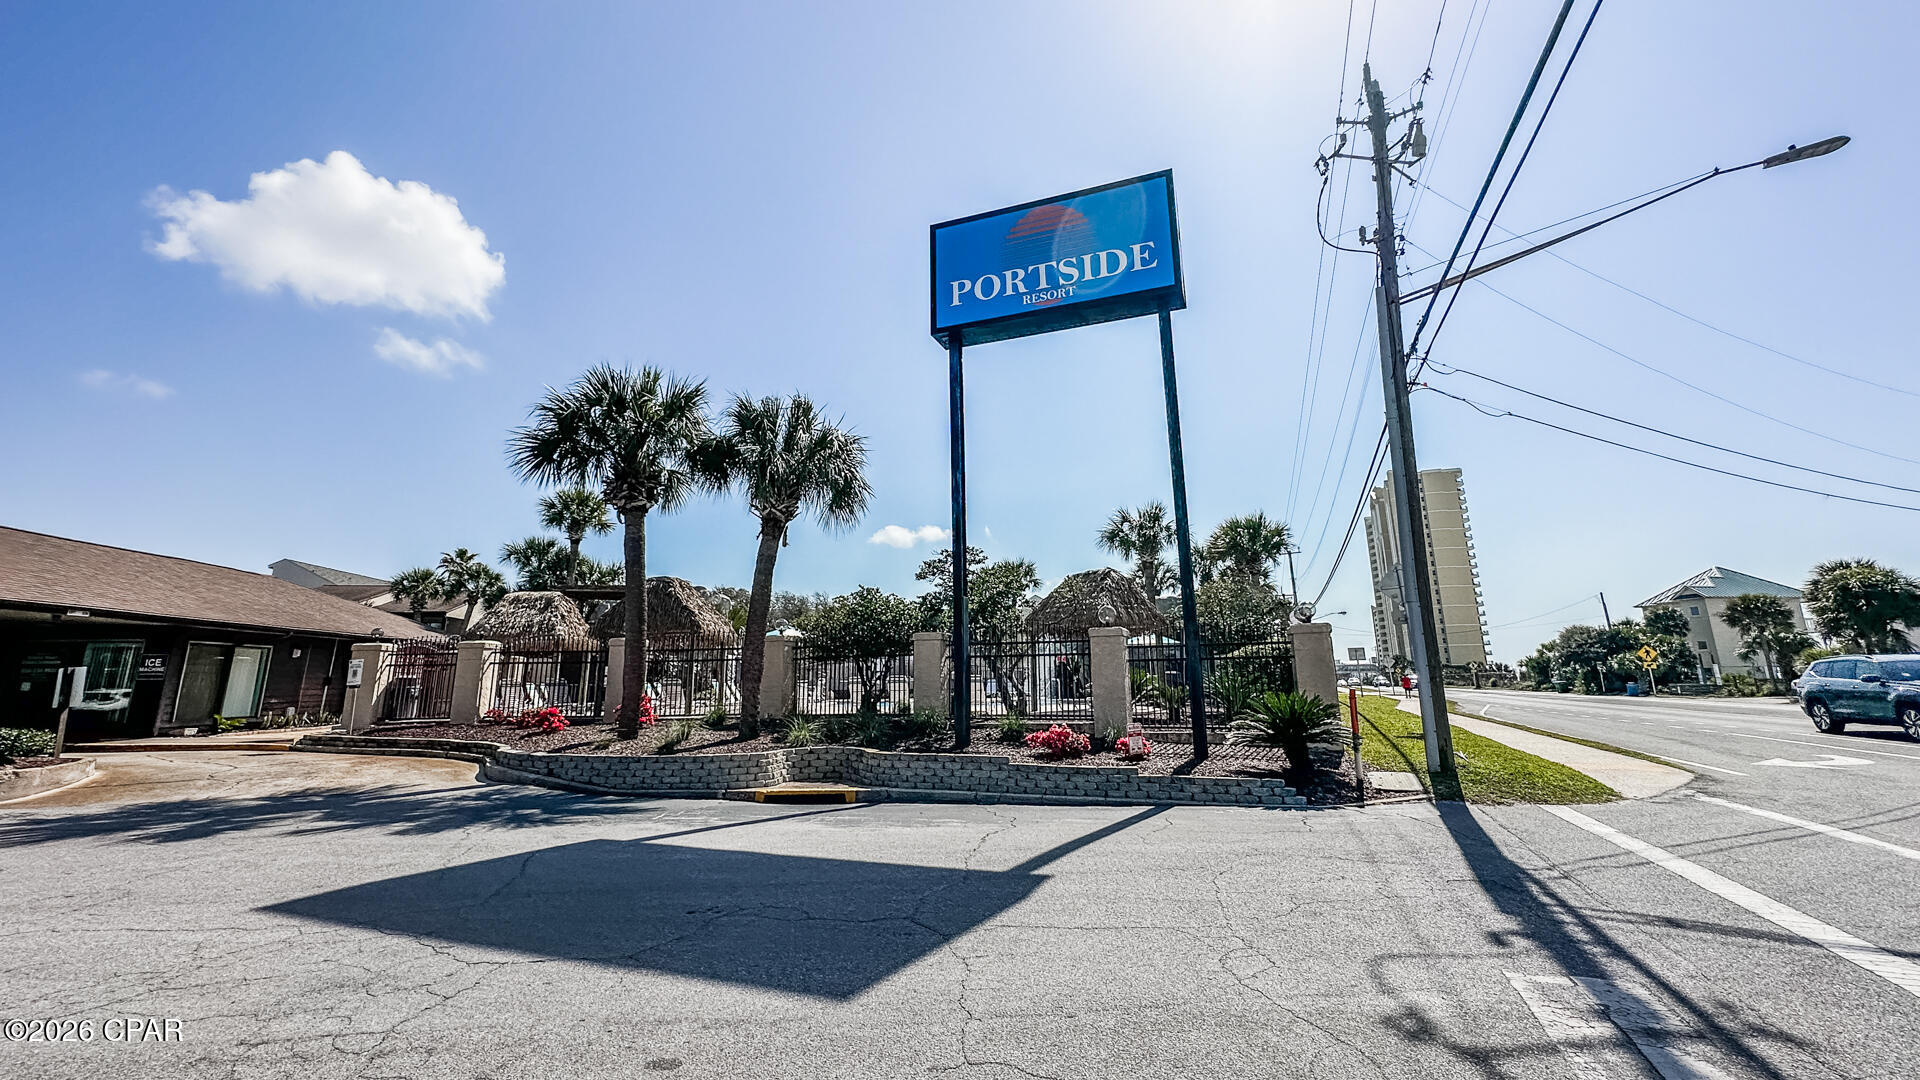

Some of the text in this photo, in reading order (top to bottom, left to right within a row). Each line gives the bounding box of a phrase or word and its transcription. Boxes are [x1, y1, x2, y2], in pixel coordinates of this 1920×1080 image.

[950, 241, 1158, 306] PORTSIDE
[1022, 285, 1077, 305] RESORT
[145, 658, 162, 667] ICE
